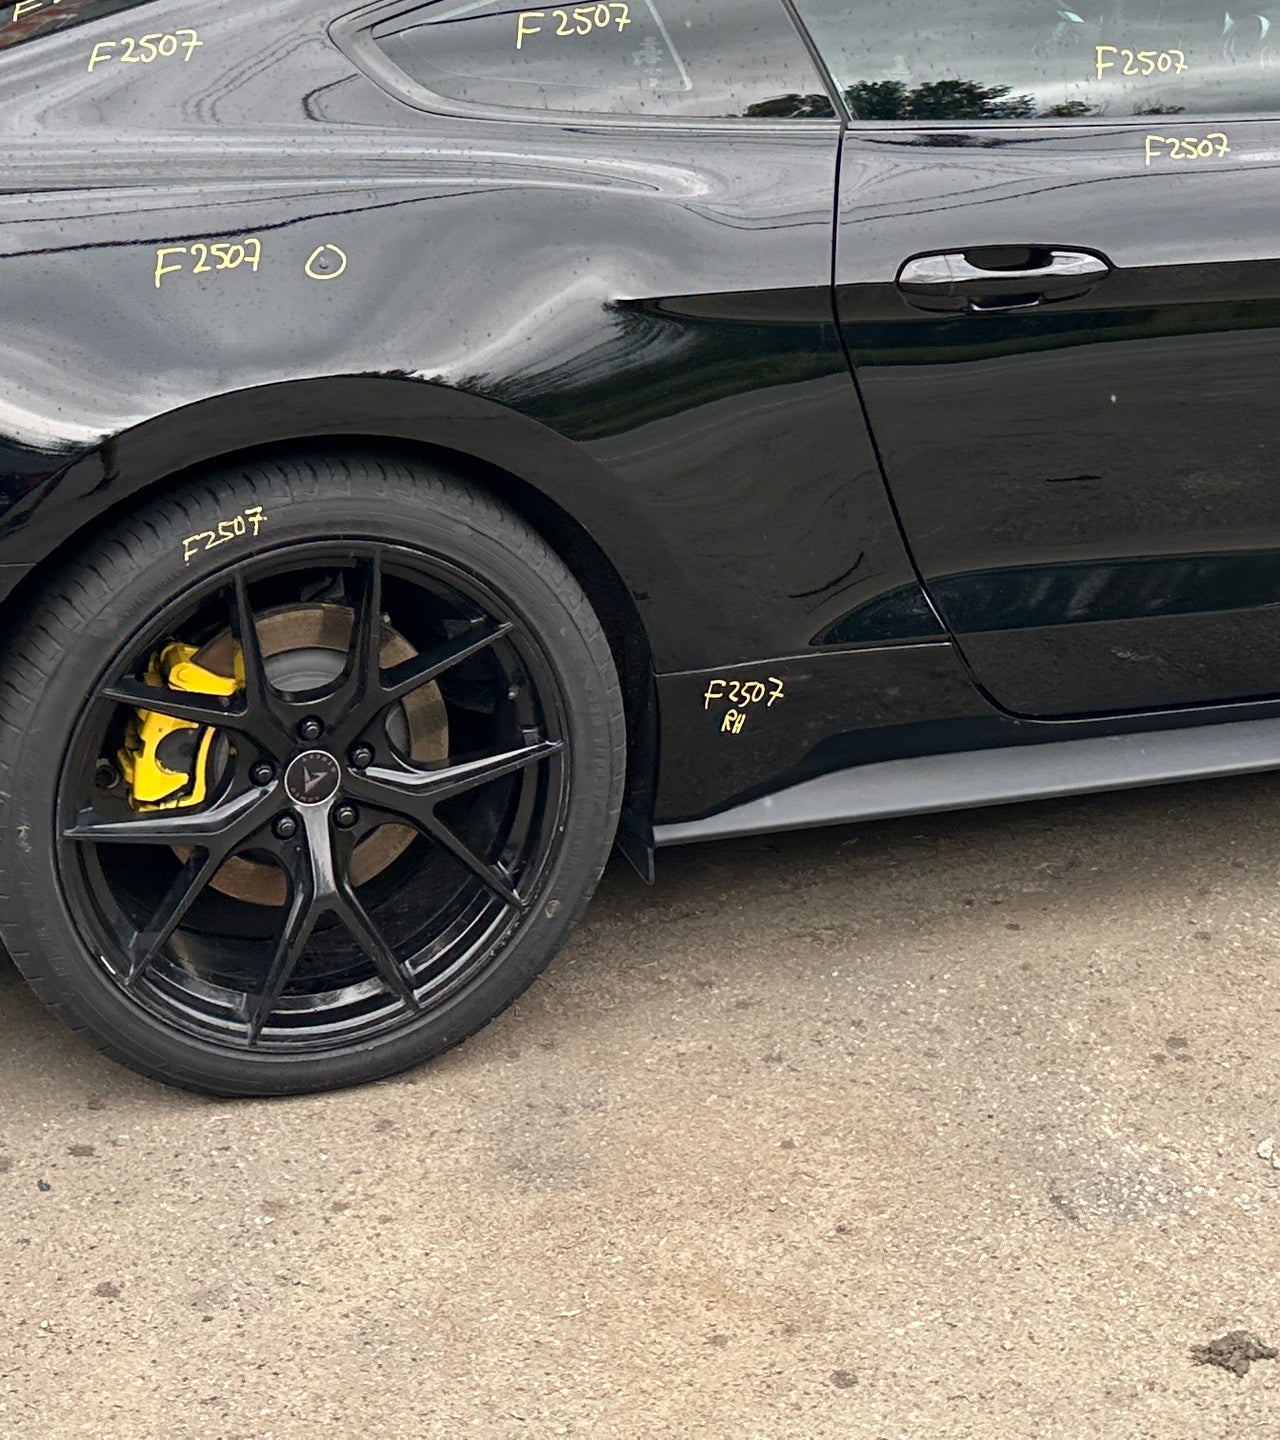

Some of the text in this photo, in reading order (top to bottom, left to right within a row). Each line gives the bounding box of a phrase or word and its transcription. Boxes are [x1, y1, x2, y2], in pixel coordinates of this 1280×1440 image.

[517, 2, 631, 49] F2507
[87, 29, 203, 72] F2507
[1095, 45, 1188, 80] F2507
[1144, 132, 1232, 166] F2507
[154, 238, 262, 288] F2507
[183, 506, 268, 566] F2507
[703, 676, 785, 706] F2507
[721, 709, 746, 735] RH
